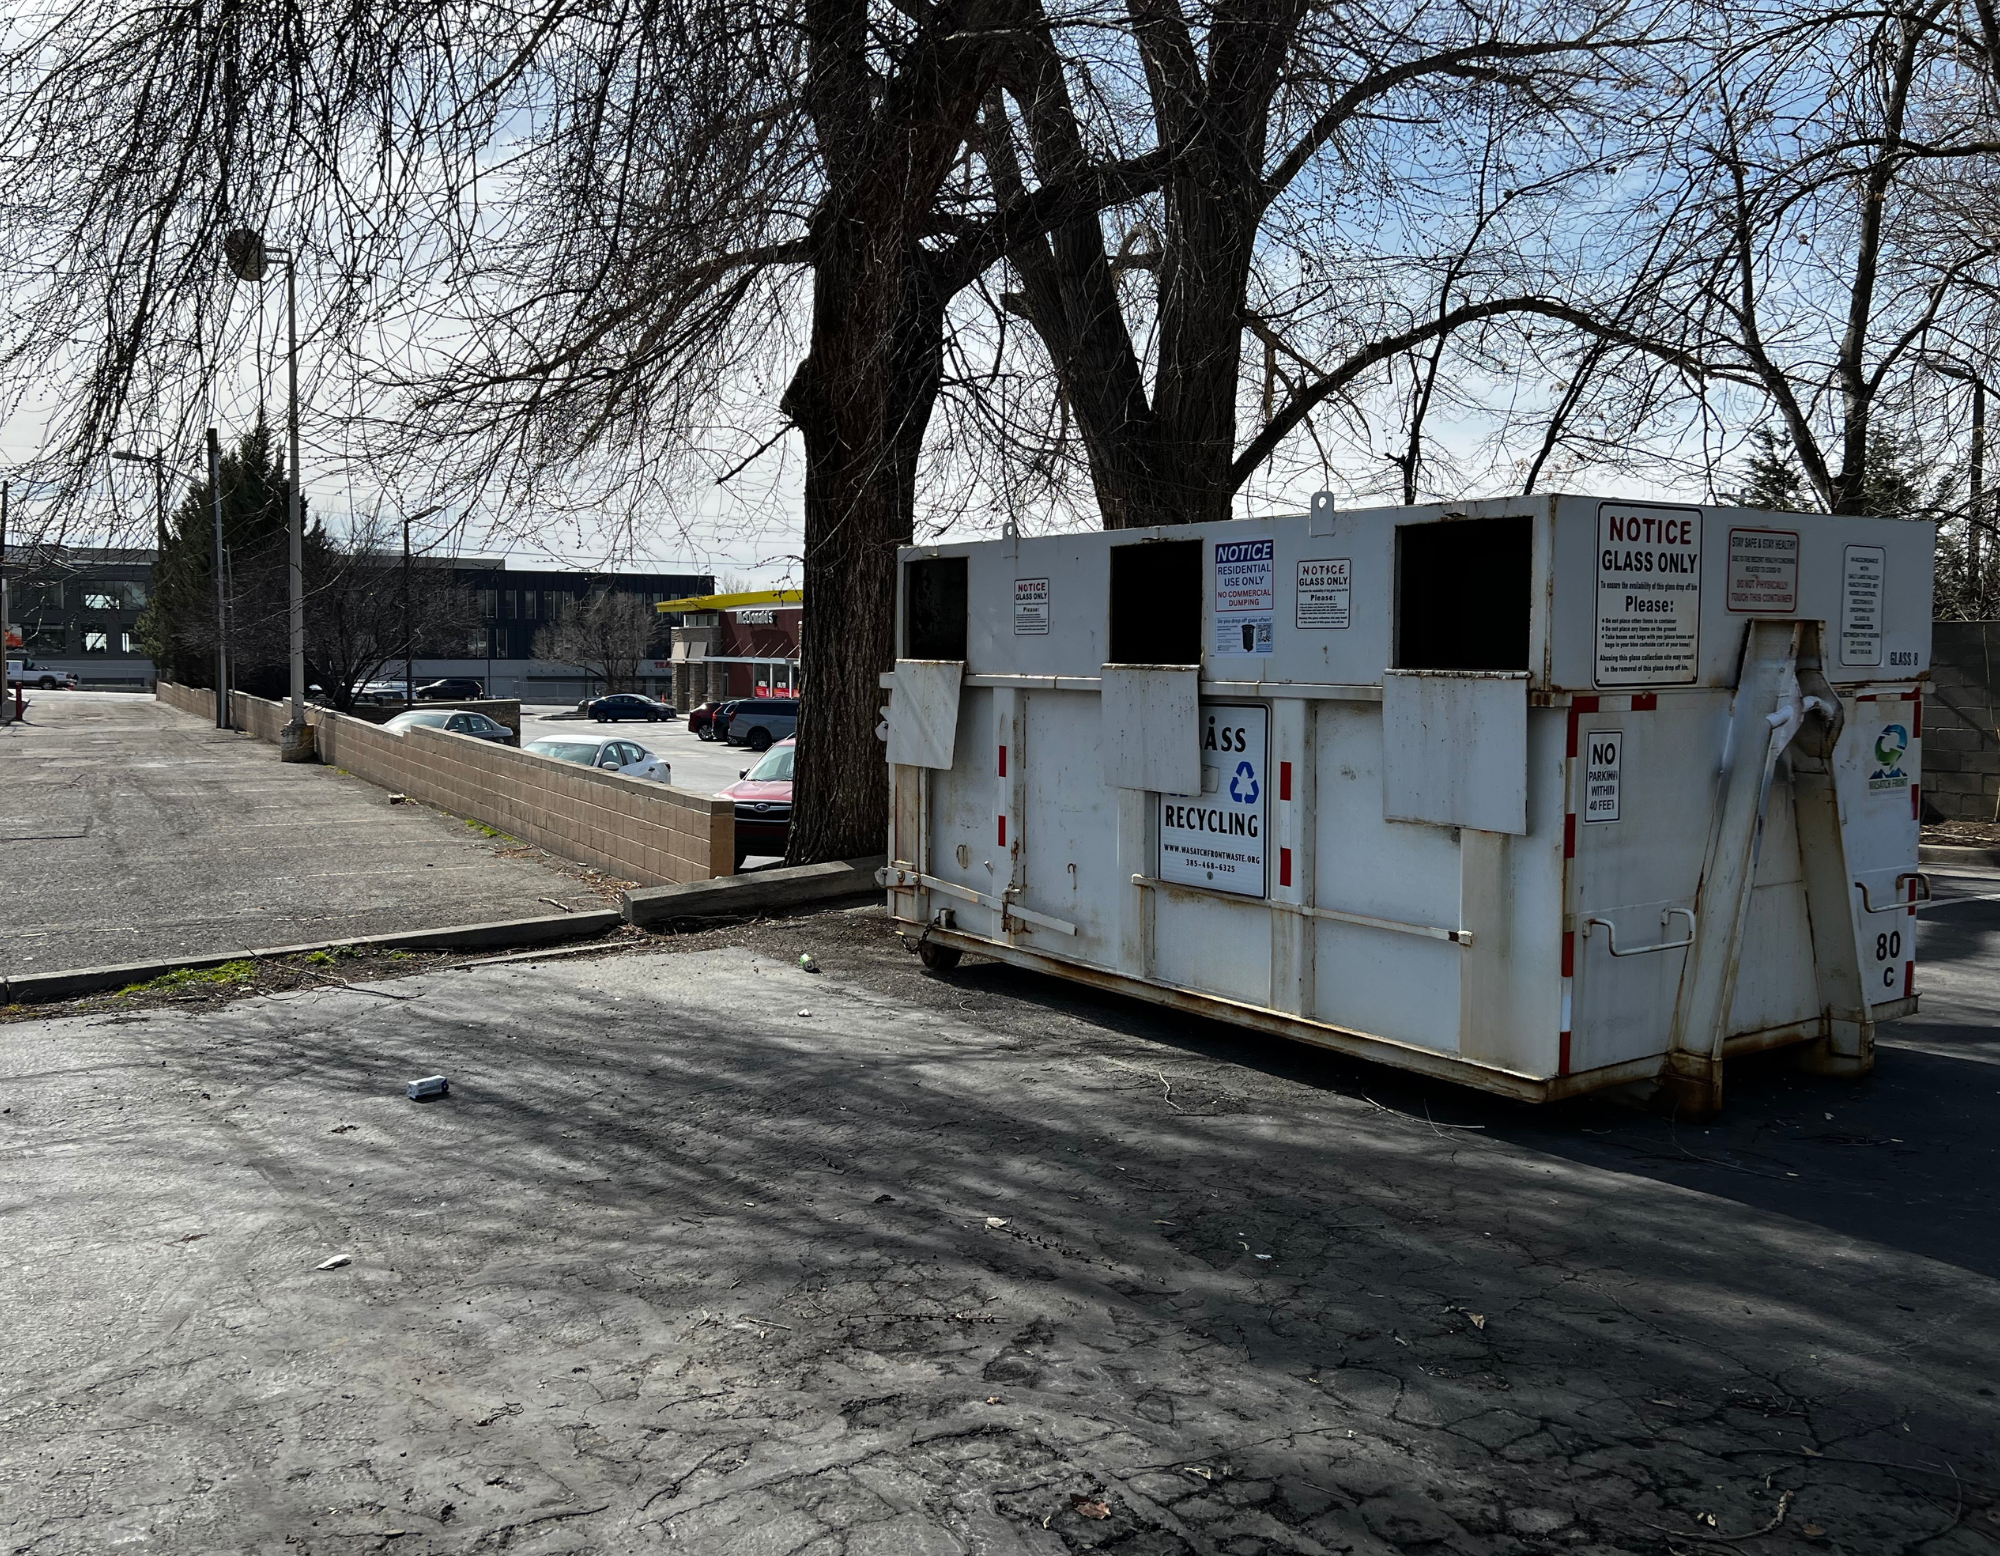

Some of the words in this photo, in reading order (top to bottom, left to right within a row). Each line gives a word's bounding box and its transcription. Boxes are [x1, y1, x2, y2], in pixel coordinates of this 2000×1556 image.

[1610, 516, 1692, 545] NOTICE
[1732, 537, 1744, 547] STAY
[1745, 538, 1757, 548] SAFE
[1758, 538, 1762, 548] &
[1762, 538, 1774, 549] STAY
[1775, 540, 1795, 550] HEALTHY
[1217, 543, 1272, 562] NOTICE
[1602, 550, 1653, 572] GLASS
[1658, 552, 1698, 574] ONLY
[1218, 564, 1271, 575] RESIDENTIAL
[1302, 564, 1345, 576] NOTICE
[1018, 583, 1046, 592] NOTICE
[1225, 577, 1240, 587] USE
[1242, 576, 1265, 586] ONLY
[1299, 578, 1324, 586] GLASS
[1327, 576, 1348, 585] ONLY
[1601, 581, 1606, 589] To
[1629, 582, 1651, 592] availability
[1665, 583, 1675, 592] glass
[1676, 583, 1684, 592] drop
[1228, 589, 1271, 598] COMMERCIAL
[1229, 599, 1260, 607] DUMPING
[1626, 596, 1674, 612] Please:
[1600, 654, 1618, 662] Abusing
[1890, 652, 1912, 666] GLASS
[1914, 652, 1918, 666] 8
[1592, 743, 1616, 765] NO
[1592, 786, 1614, 796] WITHIN
[1590, 800, 1598, 811] 40
[1598, 800, 1614, 810] FEET
[1165, 805, 1258, 838] RECYCLING
[1164, 844, 1260, 865] WWW.WASATCHFRONTWASTE.ORG
[1186, 858, 1235, 873] 385-468-6325
[1876, 931, 1900, 961] 80
[1883, 966, 1894, 988] C
